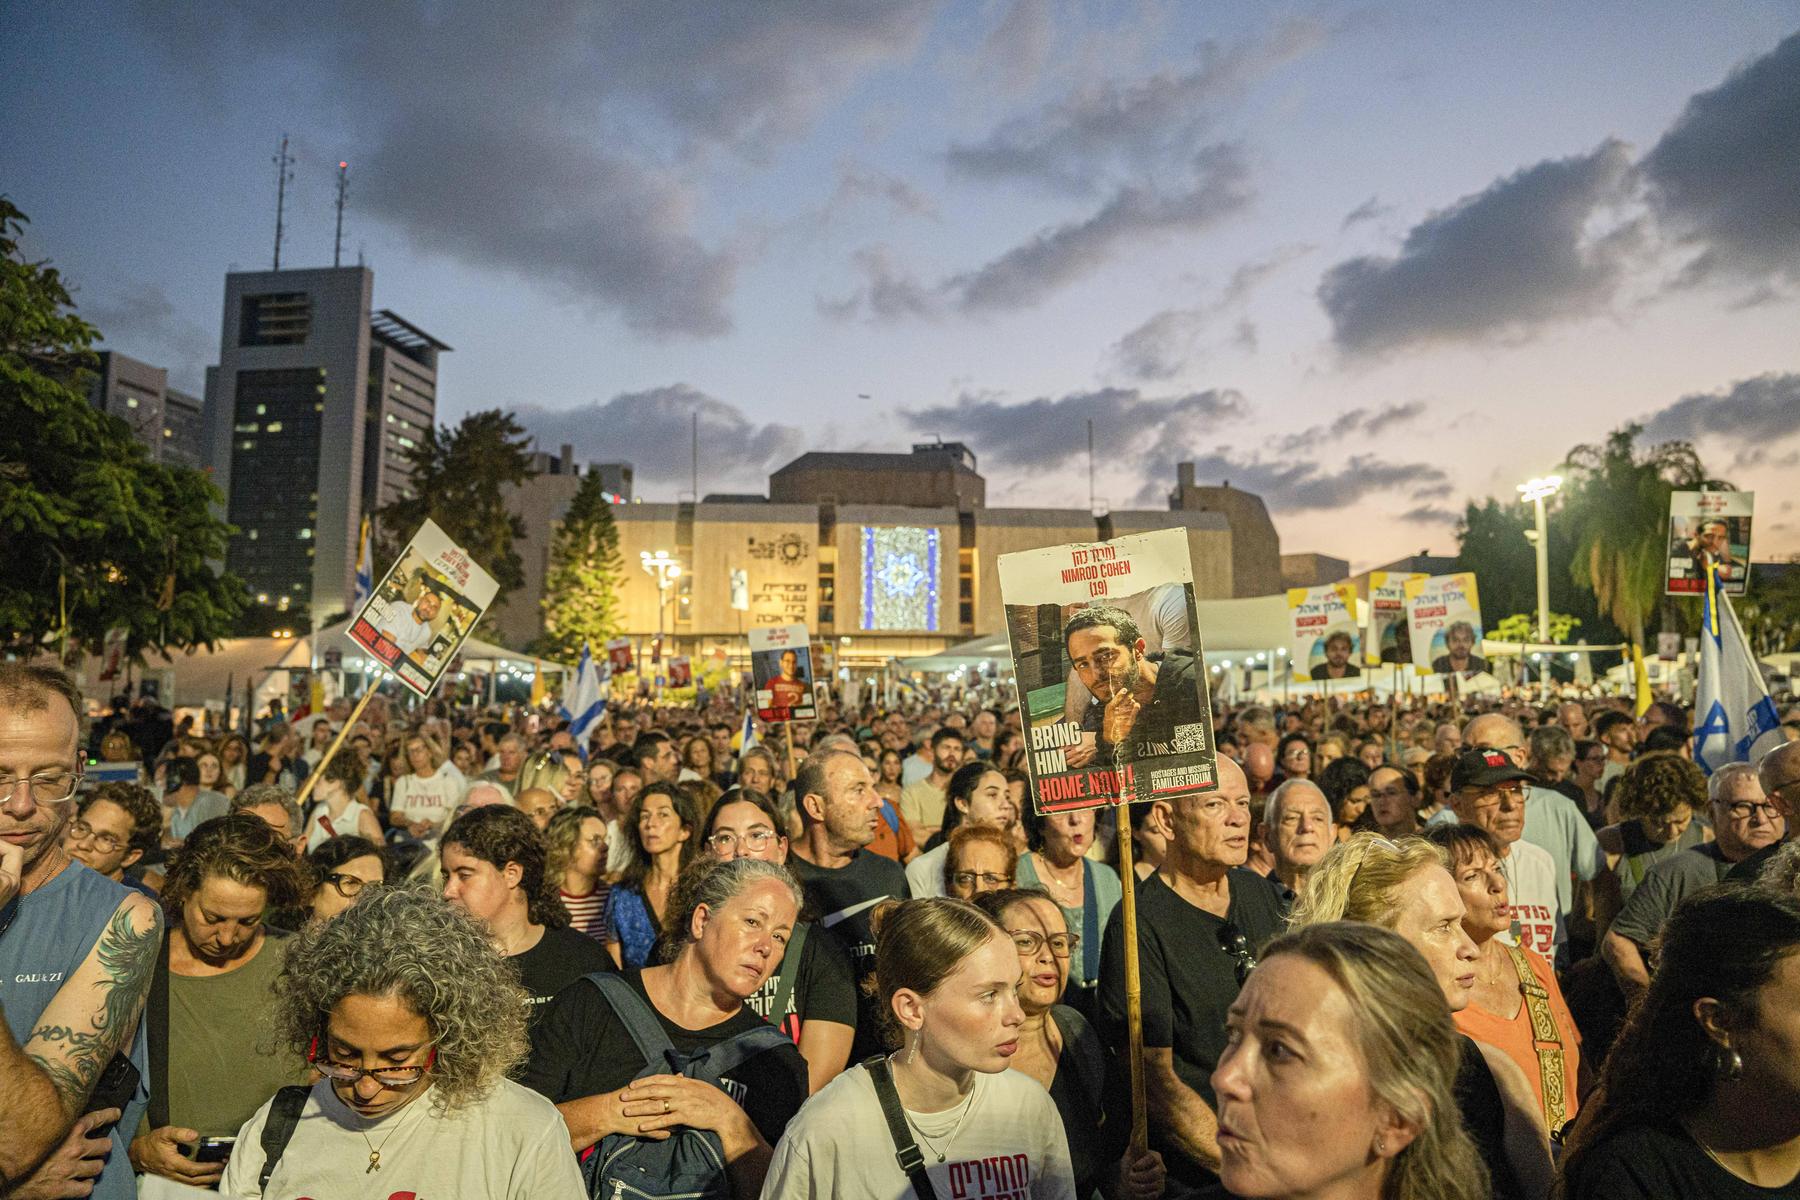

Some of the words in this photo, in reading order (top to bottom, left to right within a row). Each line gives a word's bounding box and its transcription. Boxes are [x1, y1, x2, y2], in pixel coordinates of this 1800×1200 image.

[1071, 550, 1088, 568] כהן
[1061, 566, 1098, 584] NIMROD
[1100, 560, 1131, 578] COHEN
[1089, 580, 1108, 597] (19)
[371, 594, 397, 623] BRING
[354, 619, 380, 645] HOME
[1030, 721, 1082, 750] BRING
[1034, 750, 1068, 775] HIM
[1151, 769, 1177, 779] HOSTAGES
[1176, 766, 1188, 777] AND
[1039, 773, 1086, 803] HOME
[1087, 763, 1135, 796] NOW!
[1152, 777, 1185, 790] FAMILIES
[1185, 770, 1212, 786] FORUM
[948, 1153, 1029, 1199] מחזירים
